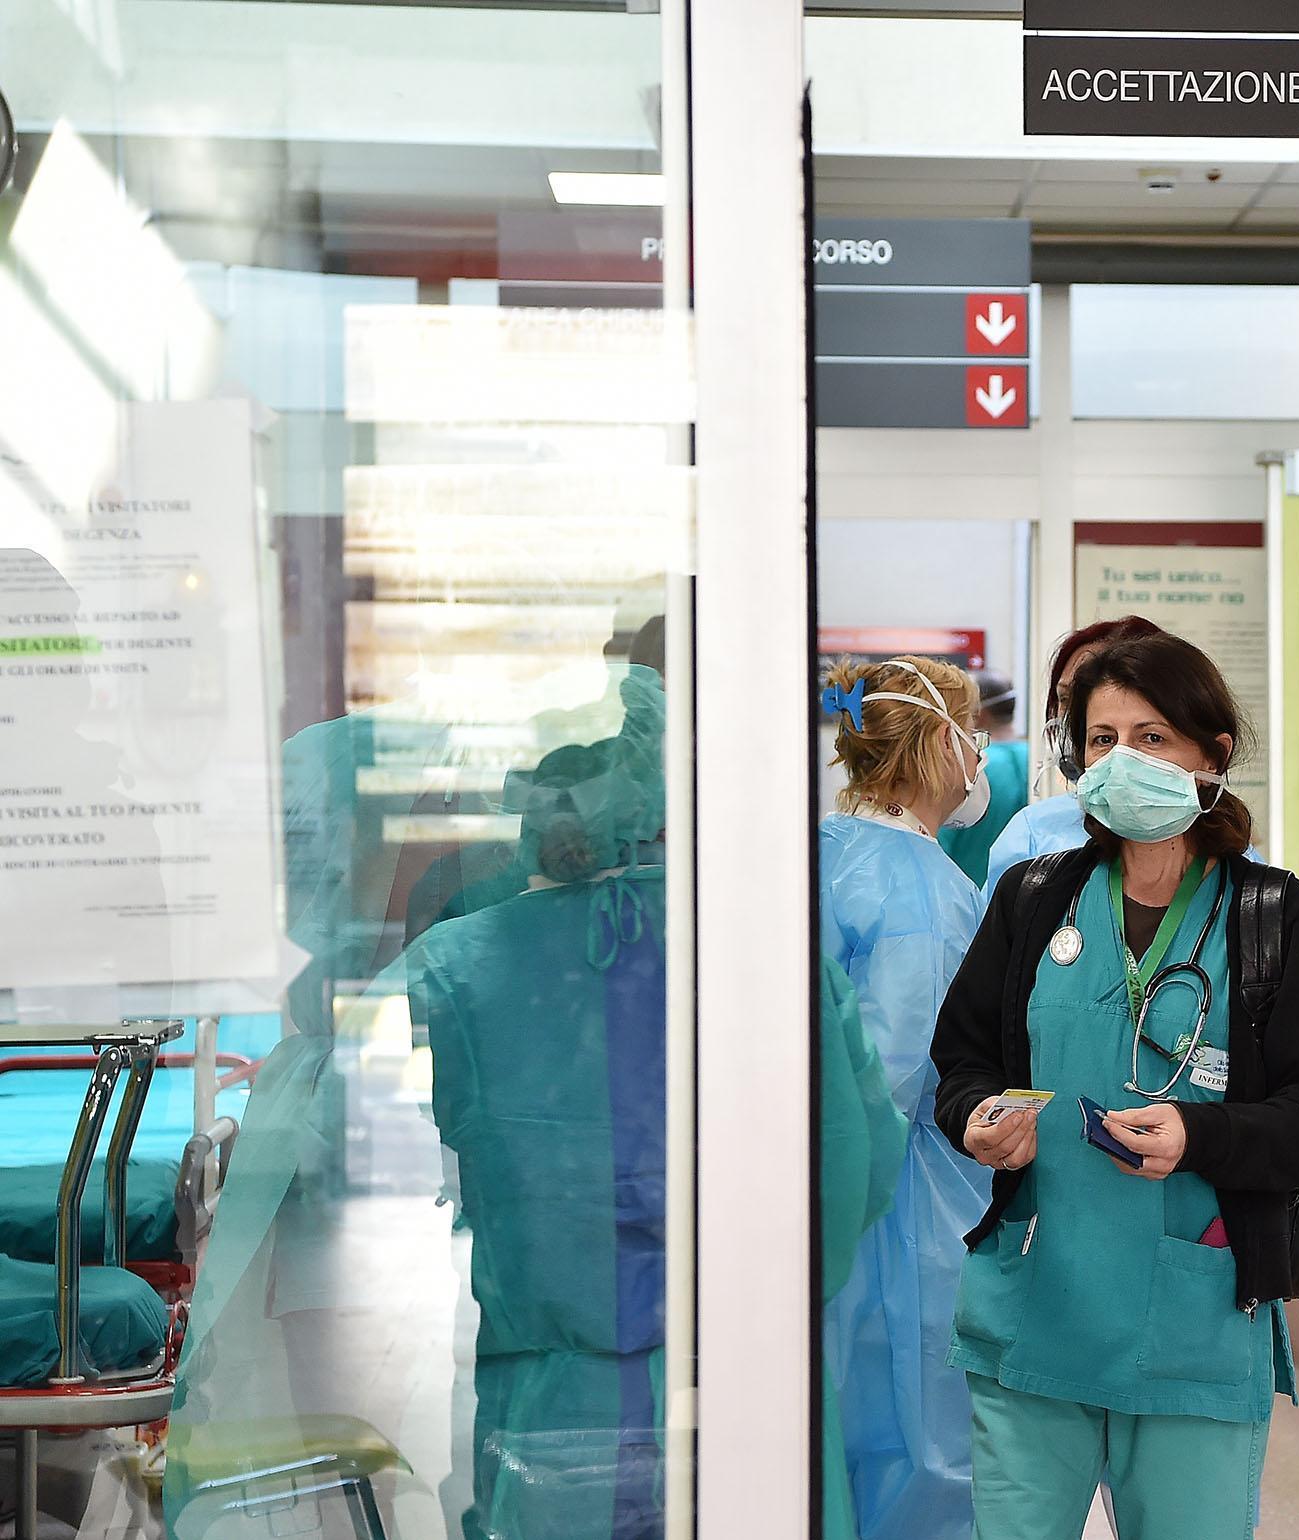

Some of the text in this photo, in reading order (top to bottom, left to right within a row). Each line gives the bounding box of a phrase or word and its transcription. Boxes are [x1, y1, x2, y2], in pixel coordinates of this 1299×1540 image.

[1103, 567, 1125, 582] Tu
[1133, 567, 1161, 582] sei
[1117, 590, 1150, 603] tuo
[1157, 592, 1212, 604] nome
